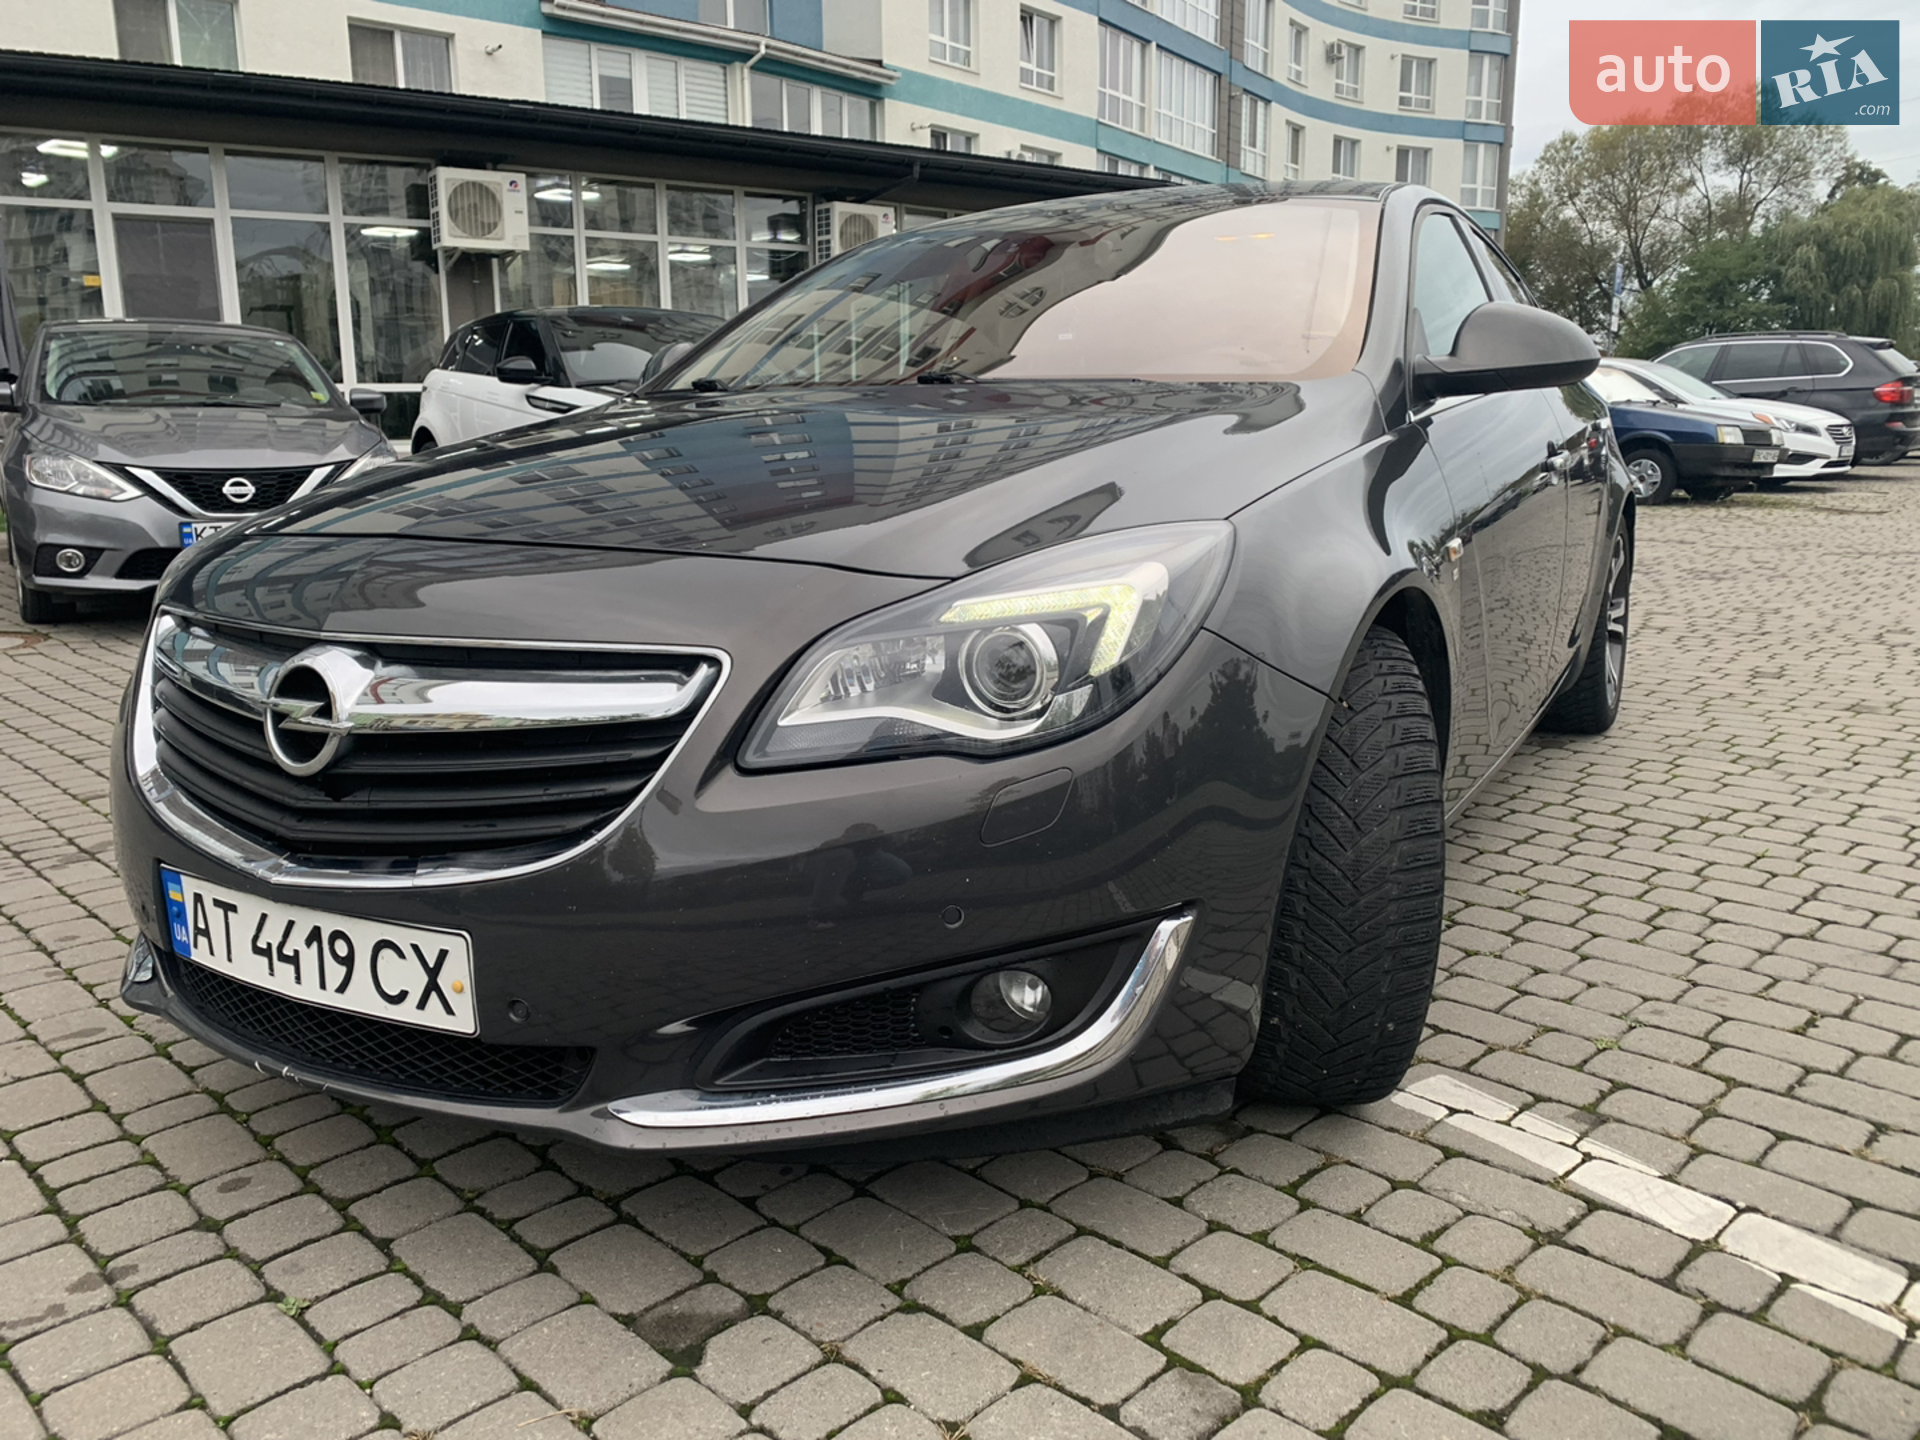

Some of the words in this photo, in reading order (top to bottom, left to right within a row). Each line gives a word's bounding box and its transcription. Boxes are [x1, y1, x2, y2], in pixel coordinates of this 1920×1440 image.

[173, 922, 190, 946] UA
[192, 892, 239, 963] AT
[251, 912, 355, 995] 4419
[369, 938, 456, 1017] CX
